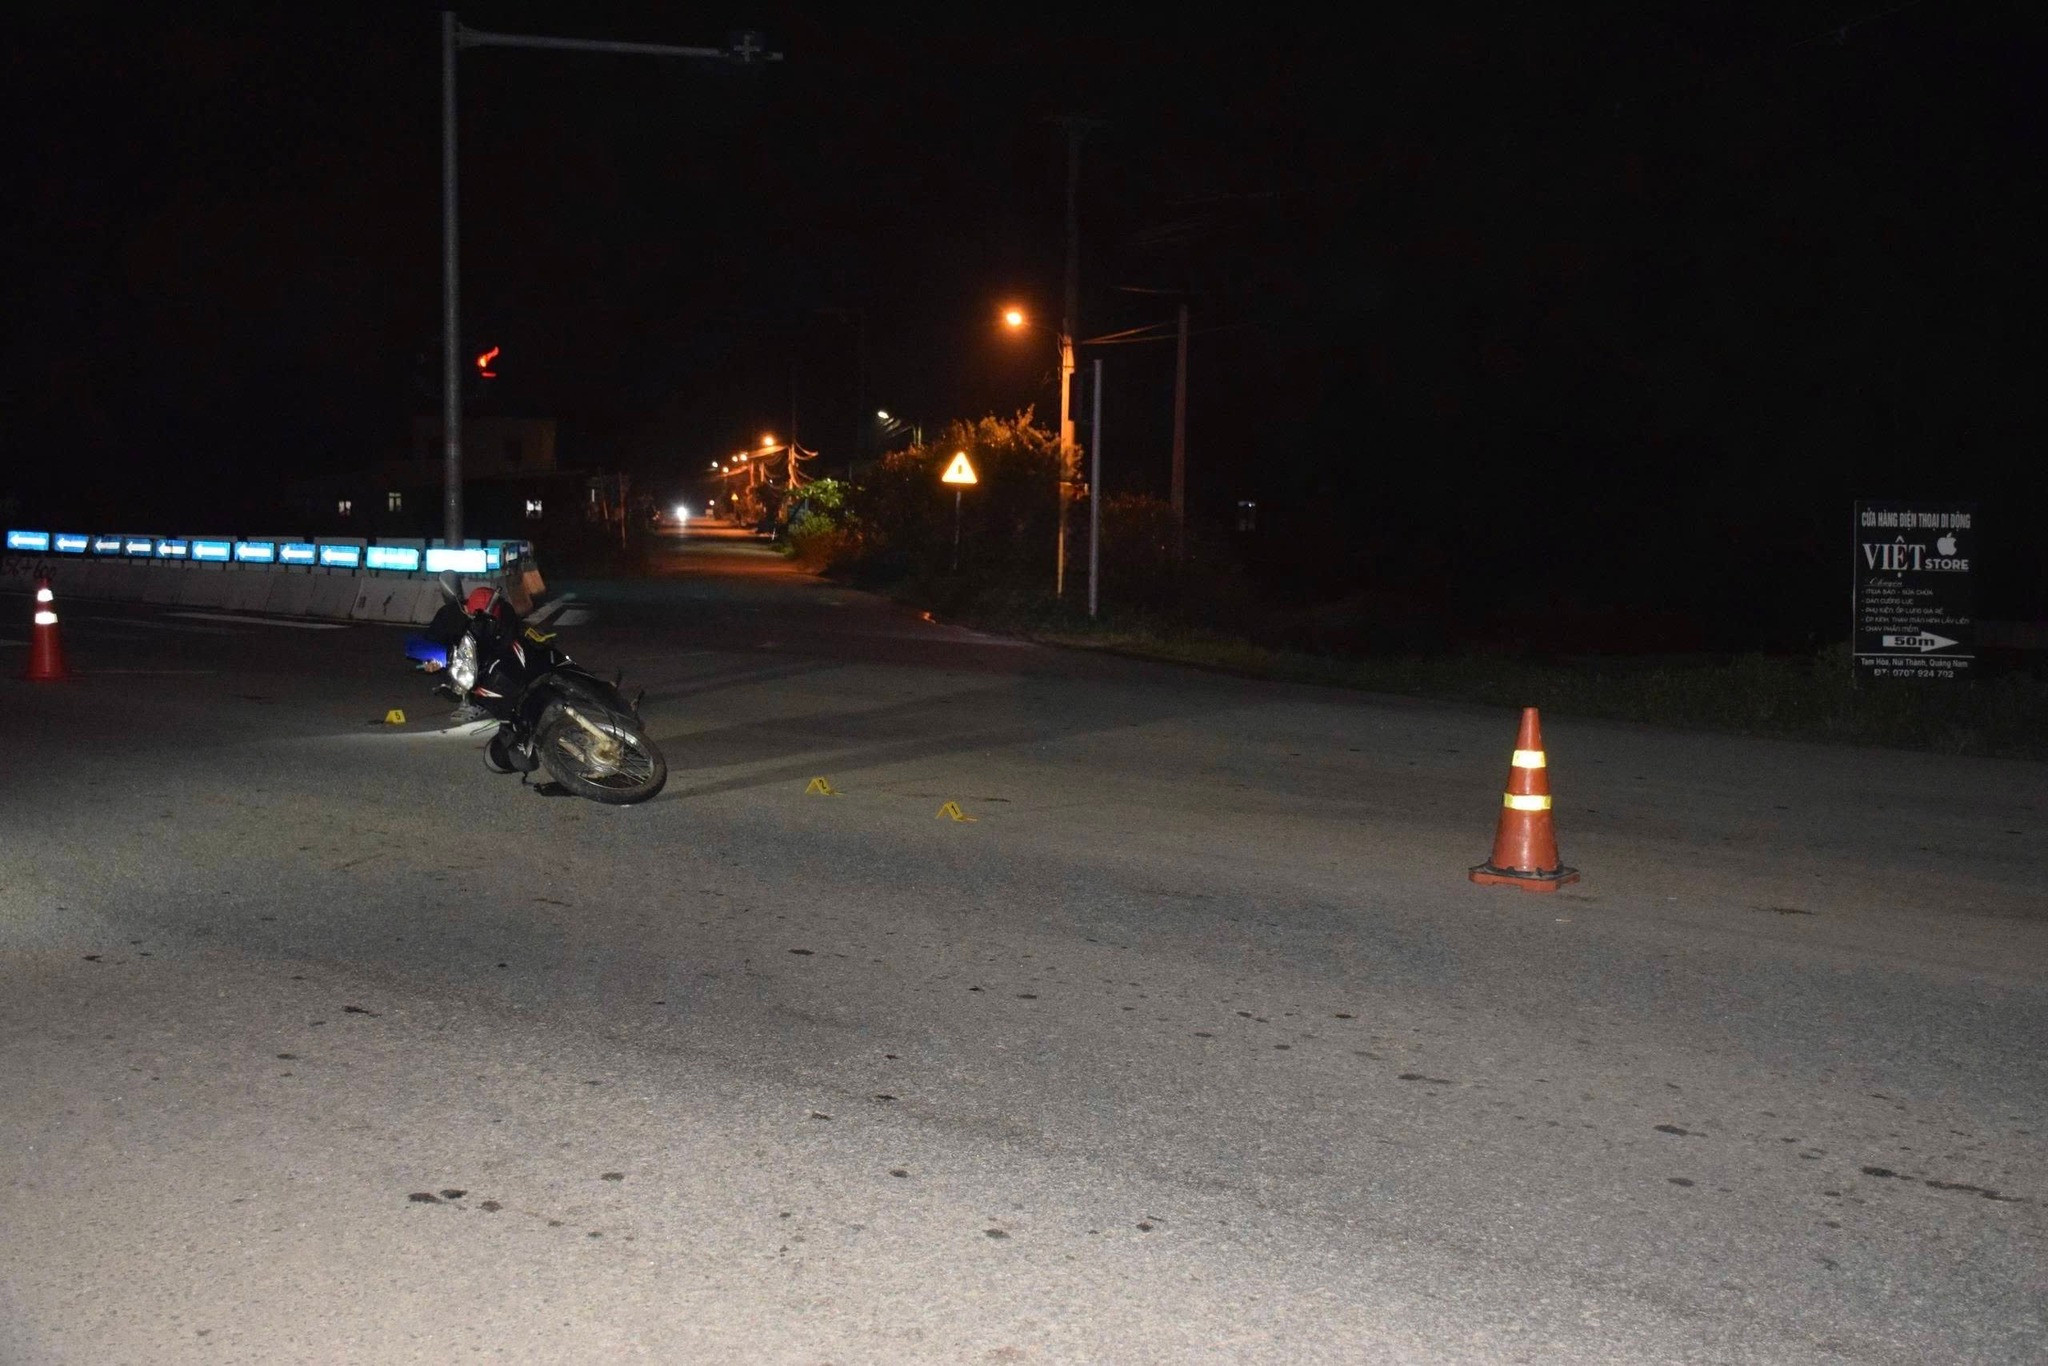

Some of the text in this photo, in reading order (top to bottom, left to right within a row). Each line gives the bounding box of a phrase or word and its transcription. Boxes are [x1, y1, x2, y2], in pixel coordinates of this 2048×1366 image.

[1878, 509, 1898, 527] HÀNG
[1899, 510, 1917, 531] ĐIỆN
[1919, 513, 1940, 531] THOẠI
[1941, 513, 1949, 528] DI
[1950, 511, 1971, 532] ĐỘNG
[1862, 535, 1969, 578] VIỆT STORE
[1894, 636, 1935, 646] 50m
[1952, 660, 1968, 668] Nam
[1918, 670, 1934, 678] 924
